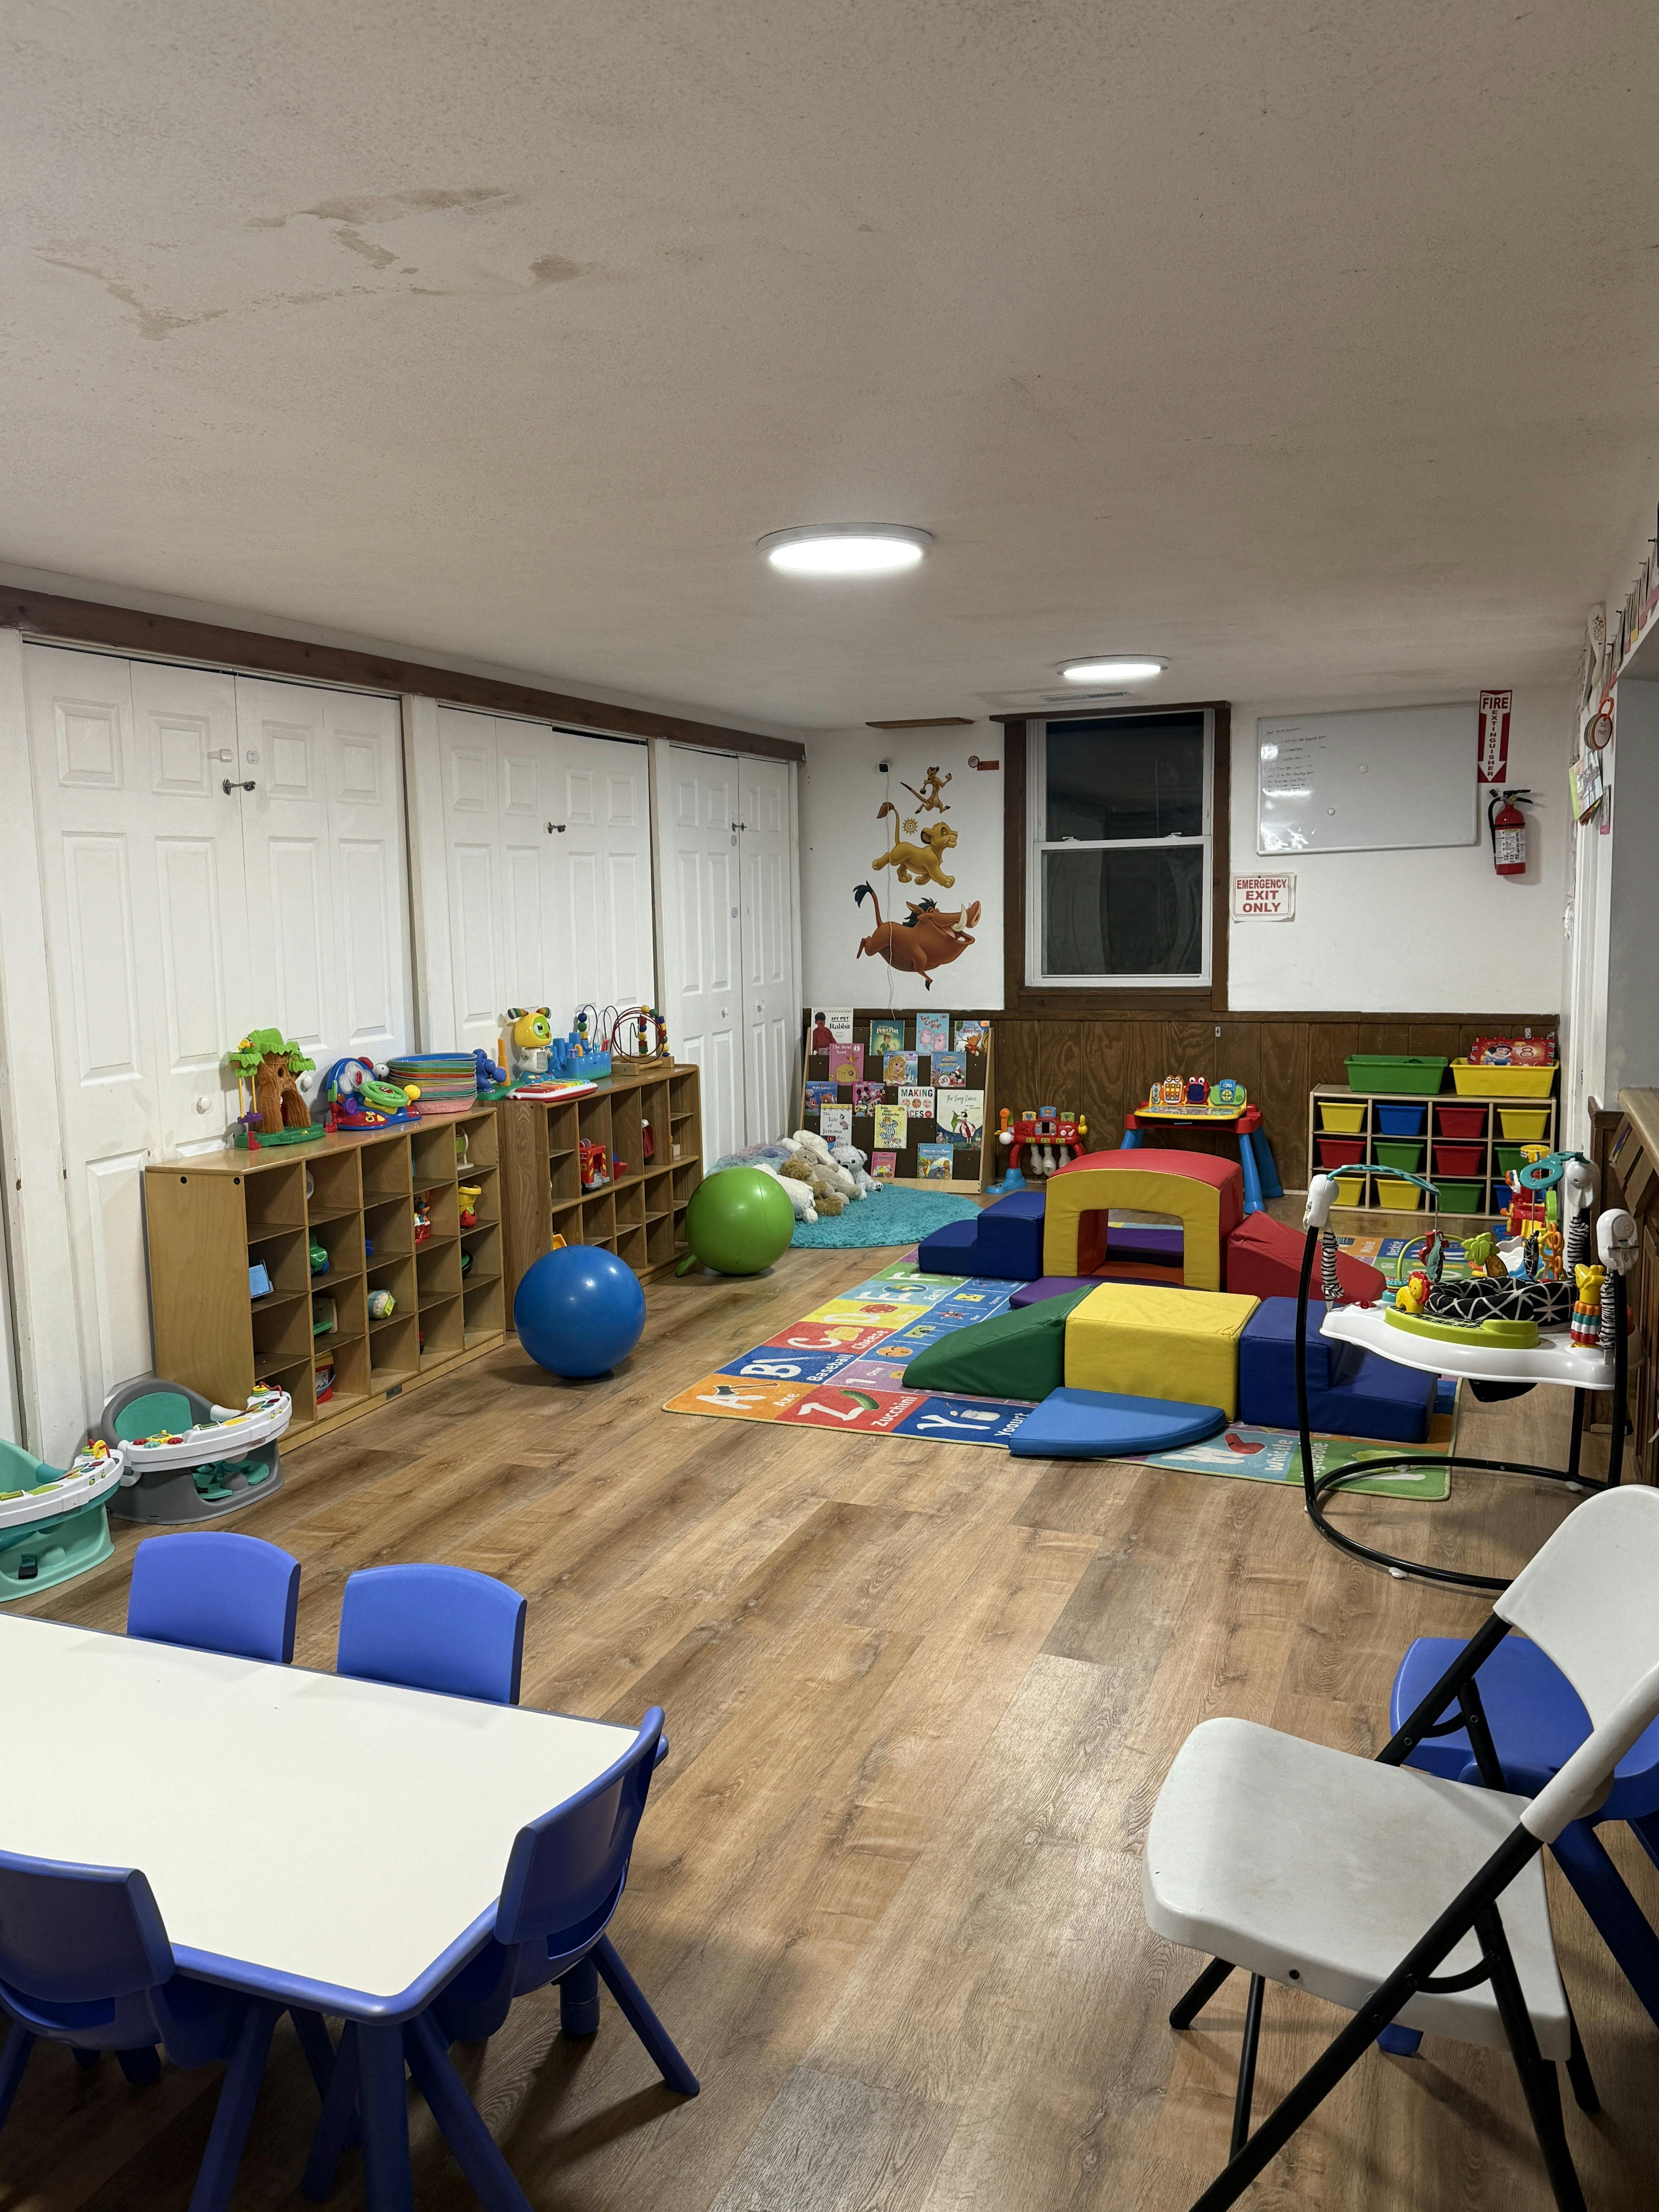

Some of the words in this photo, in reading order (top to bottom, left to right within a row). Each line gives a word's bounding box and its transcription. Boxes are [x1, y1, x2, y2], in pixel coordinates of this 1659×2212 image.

[1482, 697, 1509, 709] FIRE
[1487, 710, 1498, 776] EXTINGUISHER
[1237, 879, 1286, 889] EMERGENCY
[1246, 890, 1279, 900] EXIT
[1243, 903, 1281, 912] ONLY
[1520, 1047, 1534, 1058] 8
[886, 1272, 939, 1281] F
[854, 1291, 911, 1301] E
[824, 1313, 881, 1323] D
[787, 1337, 842, 1349] C
[851, 1330, 888, 1350] Cheese
[740, 1364, 802, 1378] B
[806, 1355, 854, 1381] Baseball
[867, 1367, 884, 1376] One
[696, 1395, 767, 1409] A
[773, 1393, 800, 1407] Axe
[797, 1402, 866, 1421] Z
[871, 1396, 918, 1427] Zucchini
[917, 1415, 991, 1430] Y
[1264, 1439, 1294, 1471] Whistle
[1300, 1443, 1328, 1478] egetable
